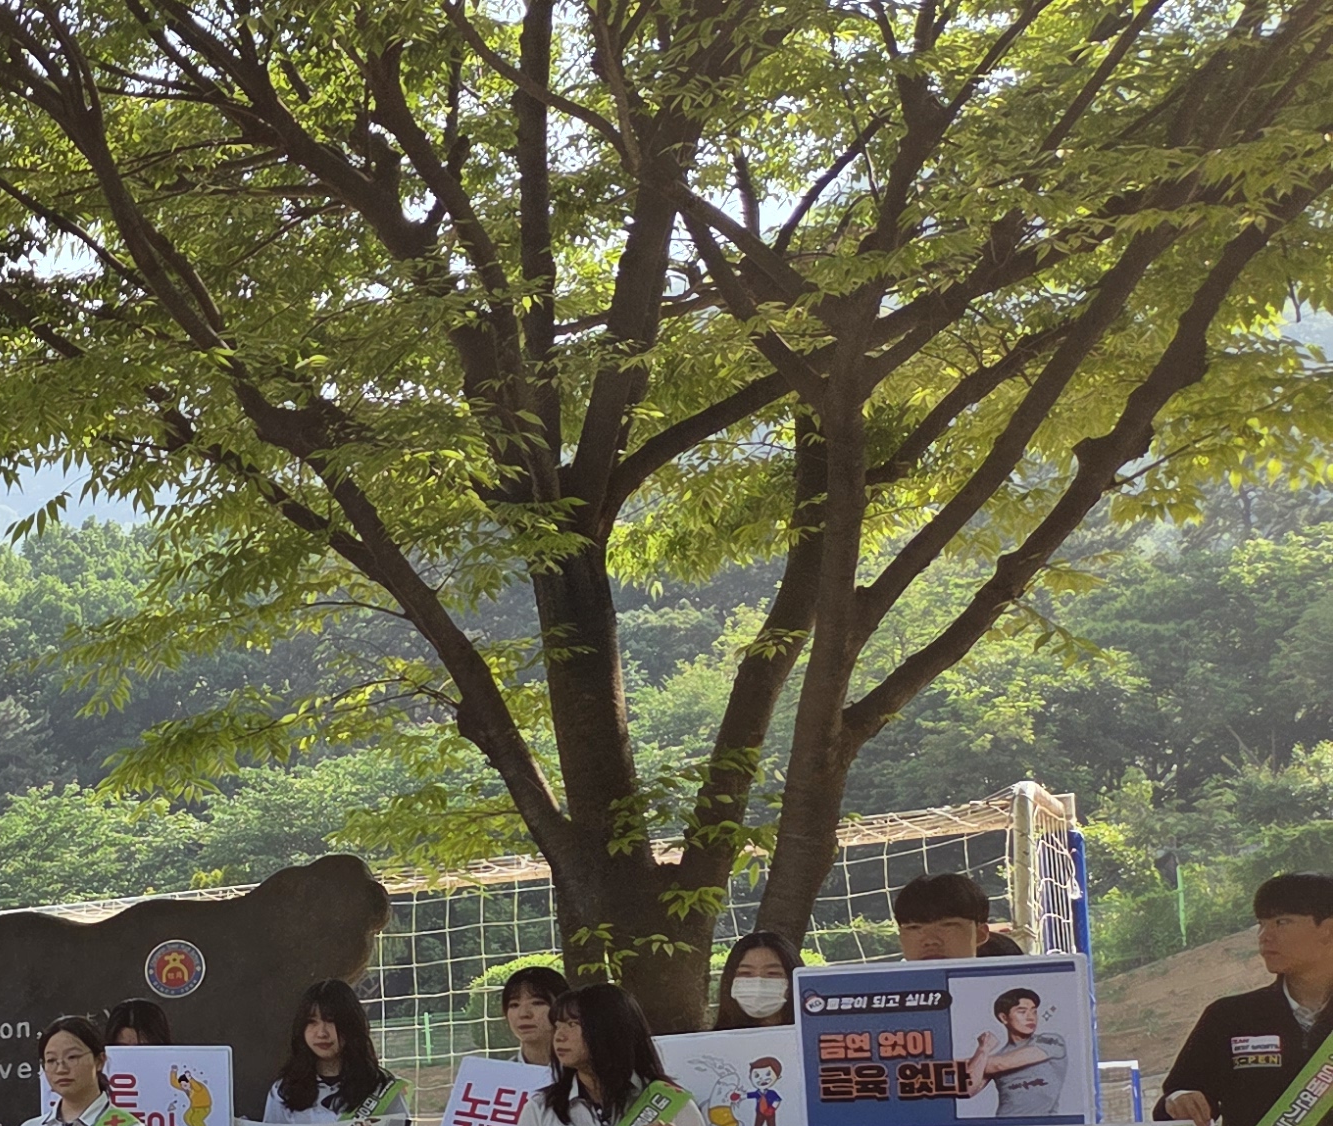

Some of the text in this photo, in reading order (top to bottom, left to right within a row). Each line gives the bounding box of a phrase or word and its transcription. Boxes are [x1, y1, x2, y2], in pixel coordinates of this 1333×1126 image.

[871, 995, 900, 1008] 되고
[820, 1030, 933, 1060] 금연 없이
[820, 1063, 889, 1099] 근육
[455, 1082, 529, 1126] 노담
